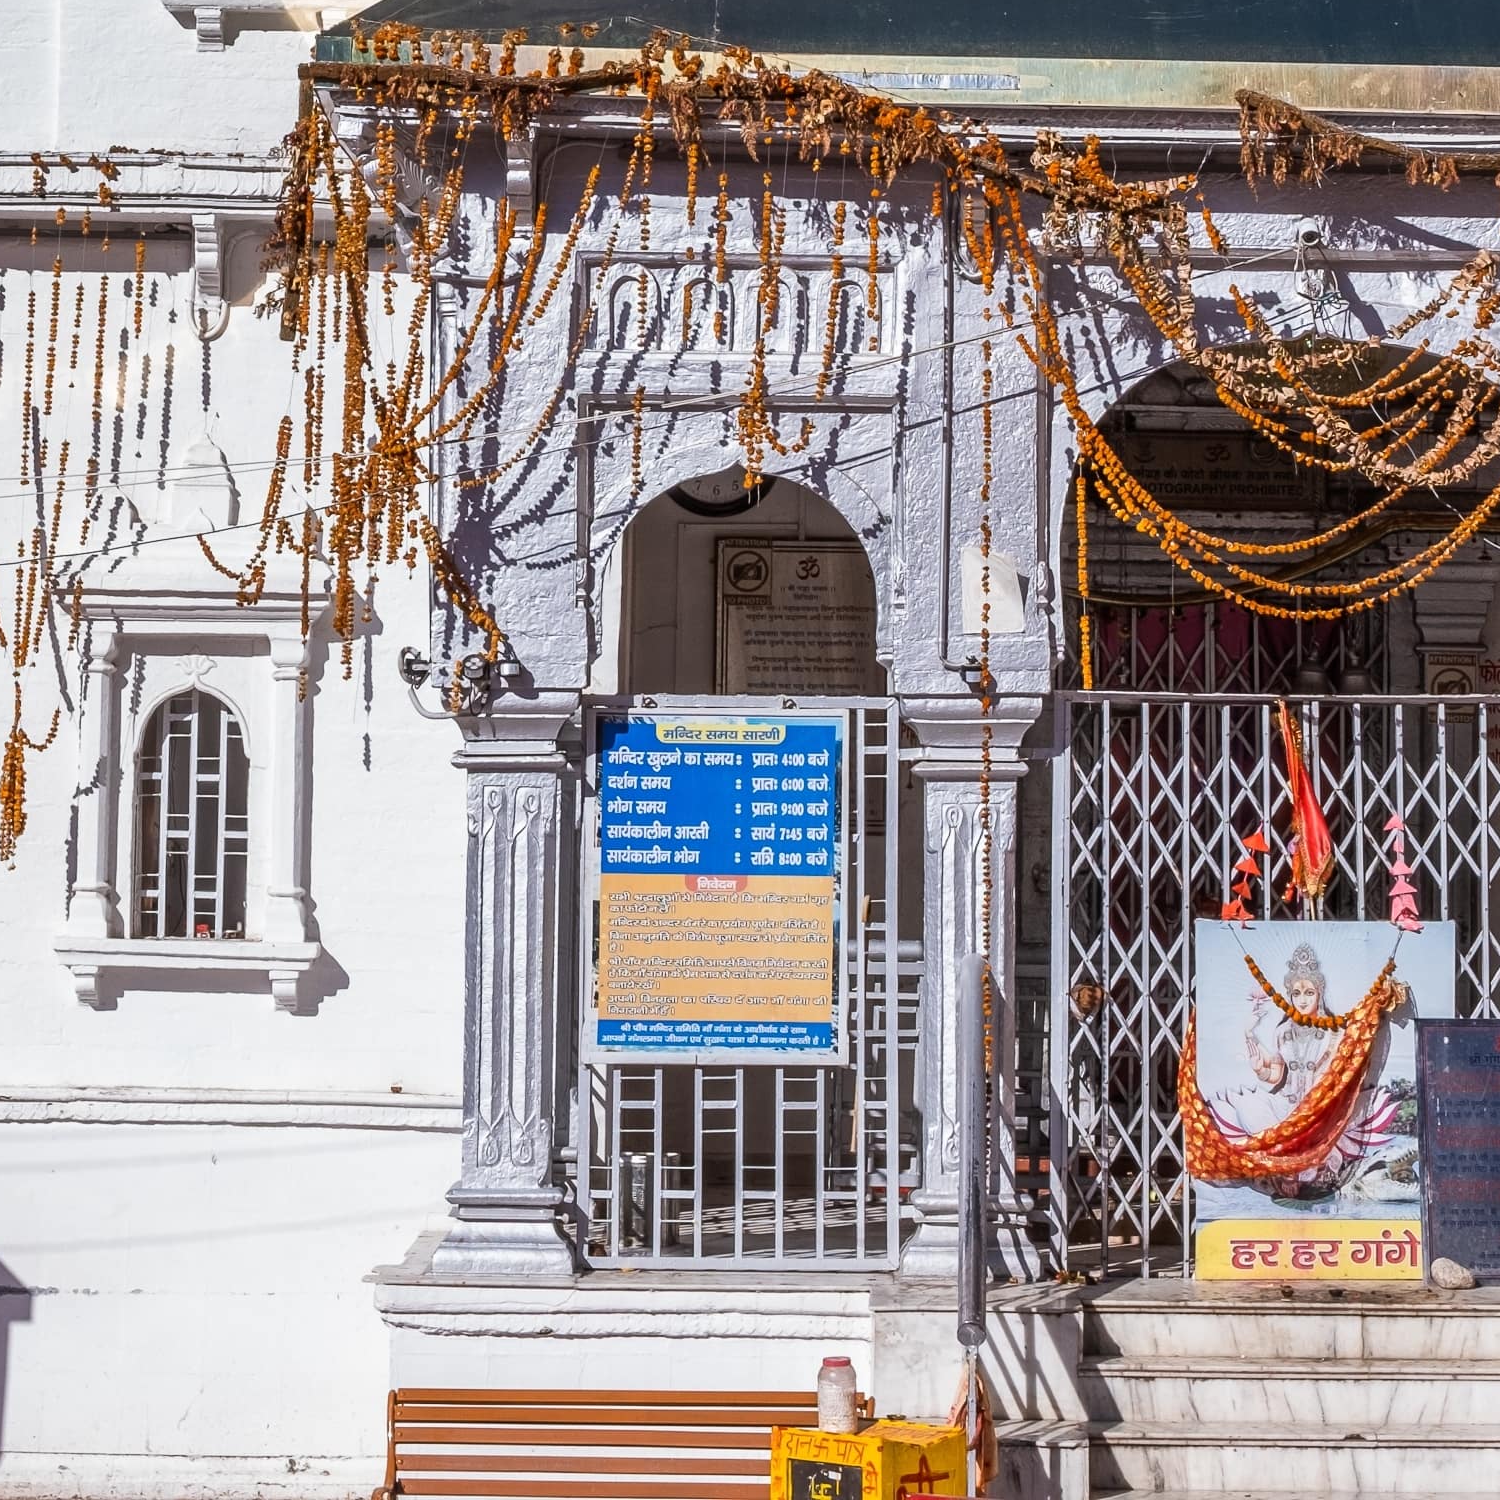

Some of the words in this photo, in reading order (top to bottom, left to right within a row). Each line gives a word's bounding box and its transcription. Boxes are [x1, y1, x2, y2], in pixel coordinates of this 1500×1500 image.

[713, 485, 720, 496] 6
[732, 481, 739, 491] 5
[1147, 484, 1226, 495] OTOGRAPHY
[796, 556, 820, 580] ॐ
[663, 726, 700, 740] मन्दिर
[706, 730, 737, 740] समय
[743, 727, 780, 742] सारणी
[608, 746, 644, 765] मन्दिर
[647, 748, 681, 772] खुलने
[684, 752, 700, 765] का
[781, 754, 804, 766] 4:00
[808, 749, 829, 767] बजे
[608, 771, 637, 790] दर्शन
[641, 777, 671, 790] समय
[781, 778, 804, 791] 6:00
[808, 774, 829, 792] बजे
[607, 796, 633, 815] भोग
[636, 802, 666, 815] समय
[781, 803, 804, 815] 9:00
[807, 799, 828, 817] बजे
[607, 821, 671, 840] सायंकालीन
[675, 821, 709, 840] आरती
[751, 823, 775, 841] सायं
[780, 827, 802, 840] 7:45
[807, 823, 828, 841] बजे
[607, 846, 671, 865] सायंकालीन
[674, 846, 699, 864] भोग
[751, 846, 773, 866] रात्रि
[779, 852, 801, 866] 8:00
[806, 848, 827, 866] बजे
[697, 877, 736, 890] निवेदन
[1230, 1239, 1285, 1269] हर
[1290, 1239, 1341, 1269] हर
[1350, 1229, 1420, 1268] गंगे
